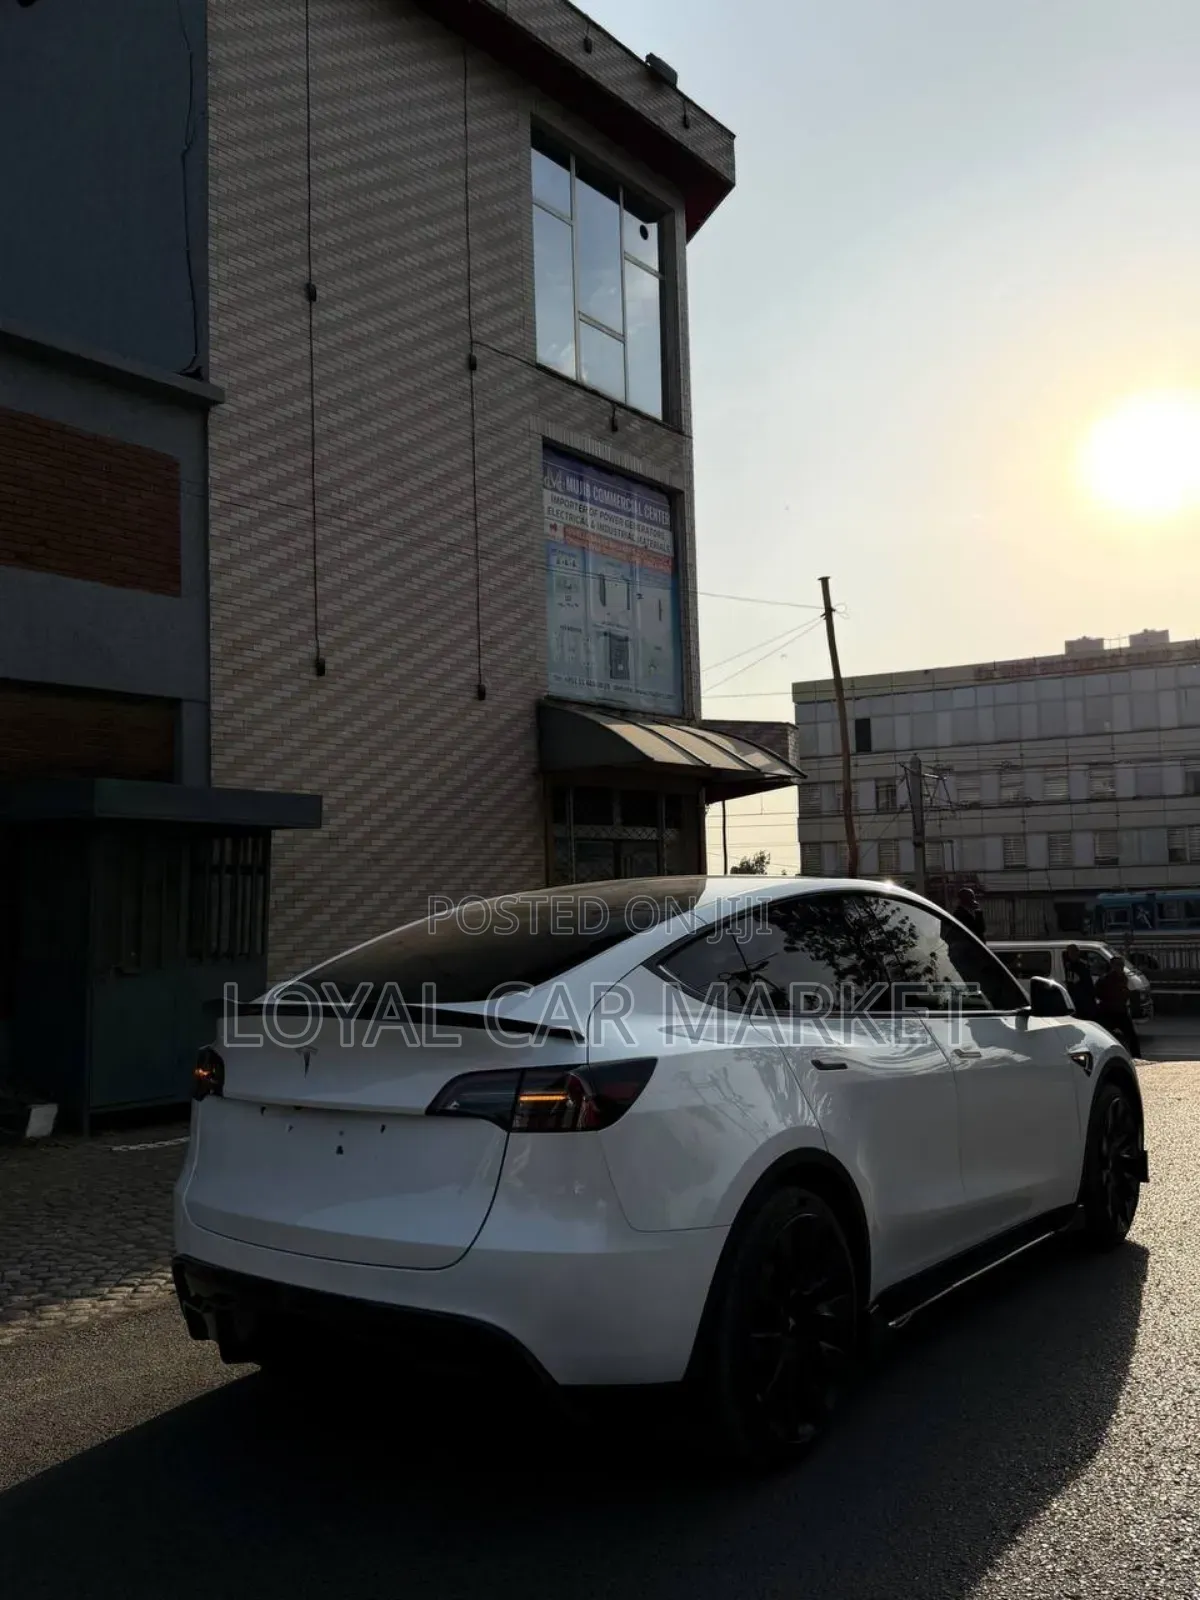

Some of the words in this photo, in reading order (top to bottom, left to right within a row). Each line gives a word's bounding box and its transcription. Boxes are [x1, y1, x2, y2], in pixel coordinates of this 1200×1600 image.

[551, 494, 588, 513] IMPORTER
[590, 507, 598, 518] OF
[599, 510, 624, 527] POWER
[624, 519, 666, 540] GENERATORS
[593, 484, 643, 517] COMMERCIAL
[547, 506, 588, 527] ELECTRICAL
[597, 522, 634, 542] INDUSTRIAL
[637, 535, 671, 554] MATERIALS
